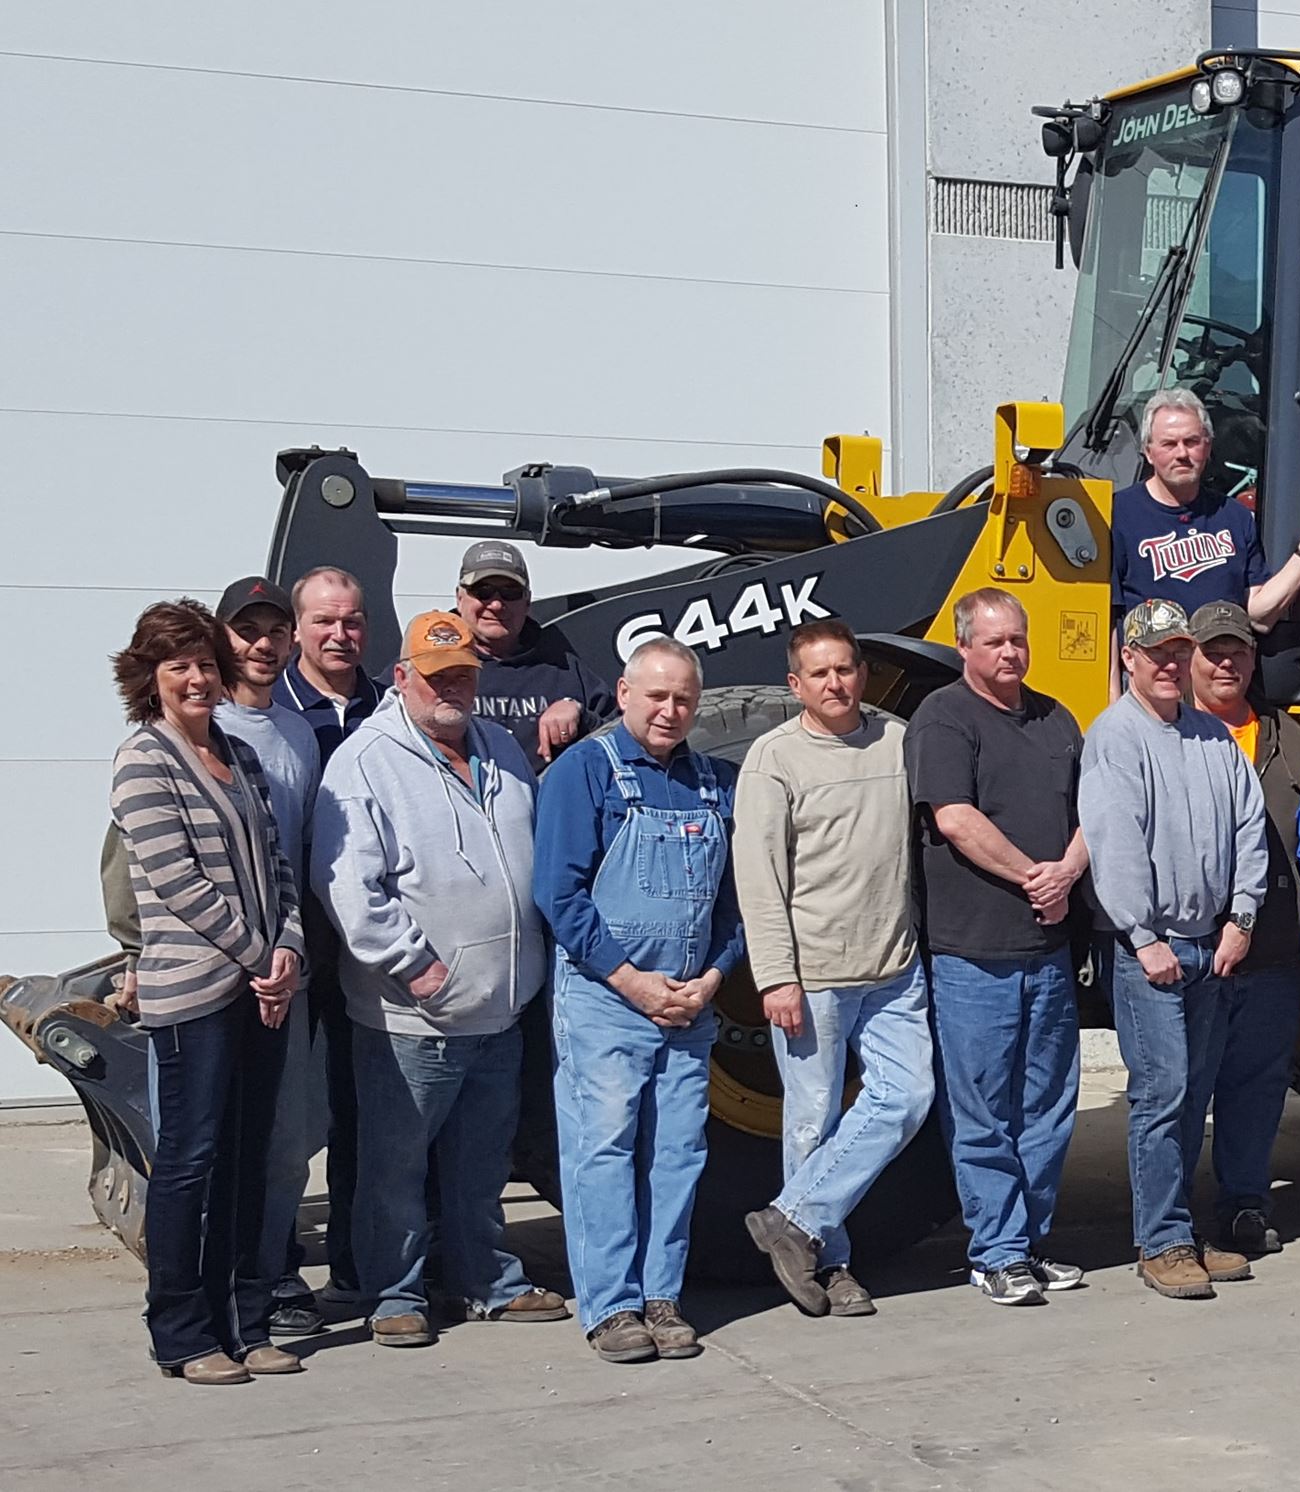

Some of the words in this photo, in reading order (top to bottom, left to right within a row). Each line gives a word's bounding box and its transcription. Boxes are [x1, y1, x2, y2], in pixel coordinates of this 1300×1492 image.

[1112, 114, 1161, 147] JOHN
[1162, 103, 1217, 133] DEE
[1138, 529, 1236, 582] Twins
[613, 574, 834, 667] 644K
[471, 695, 549, 717] ONTANA
